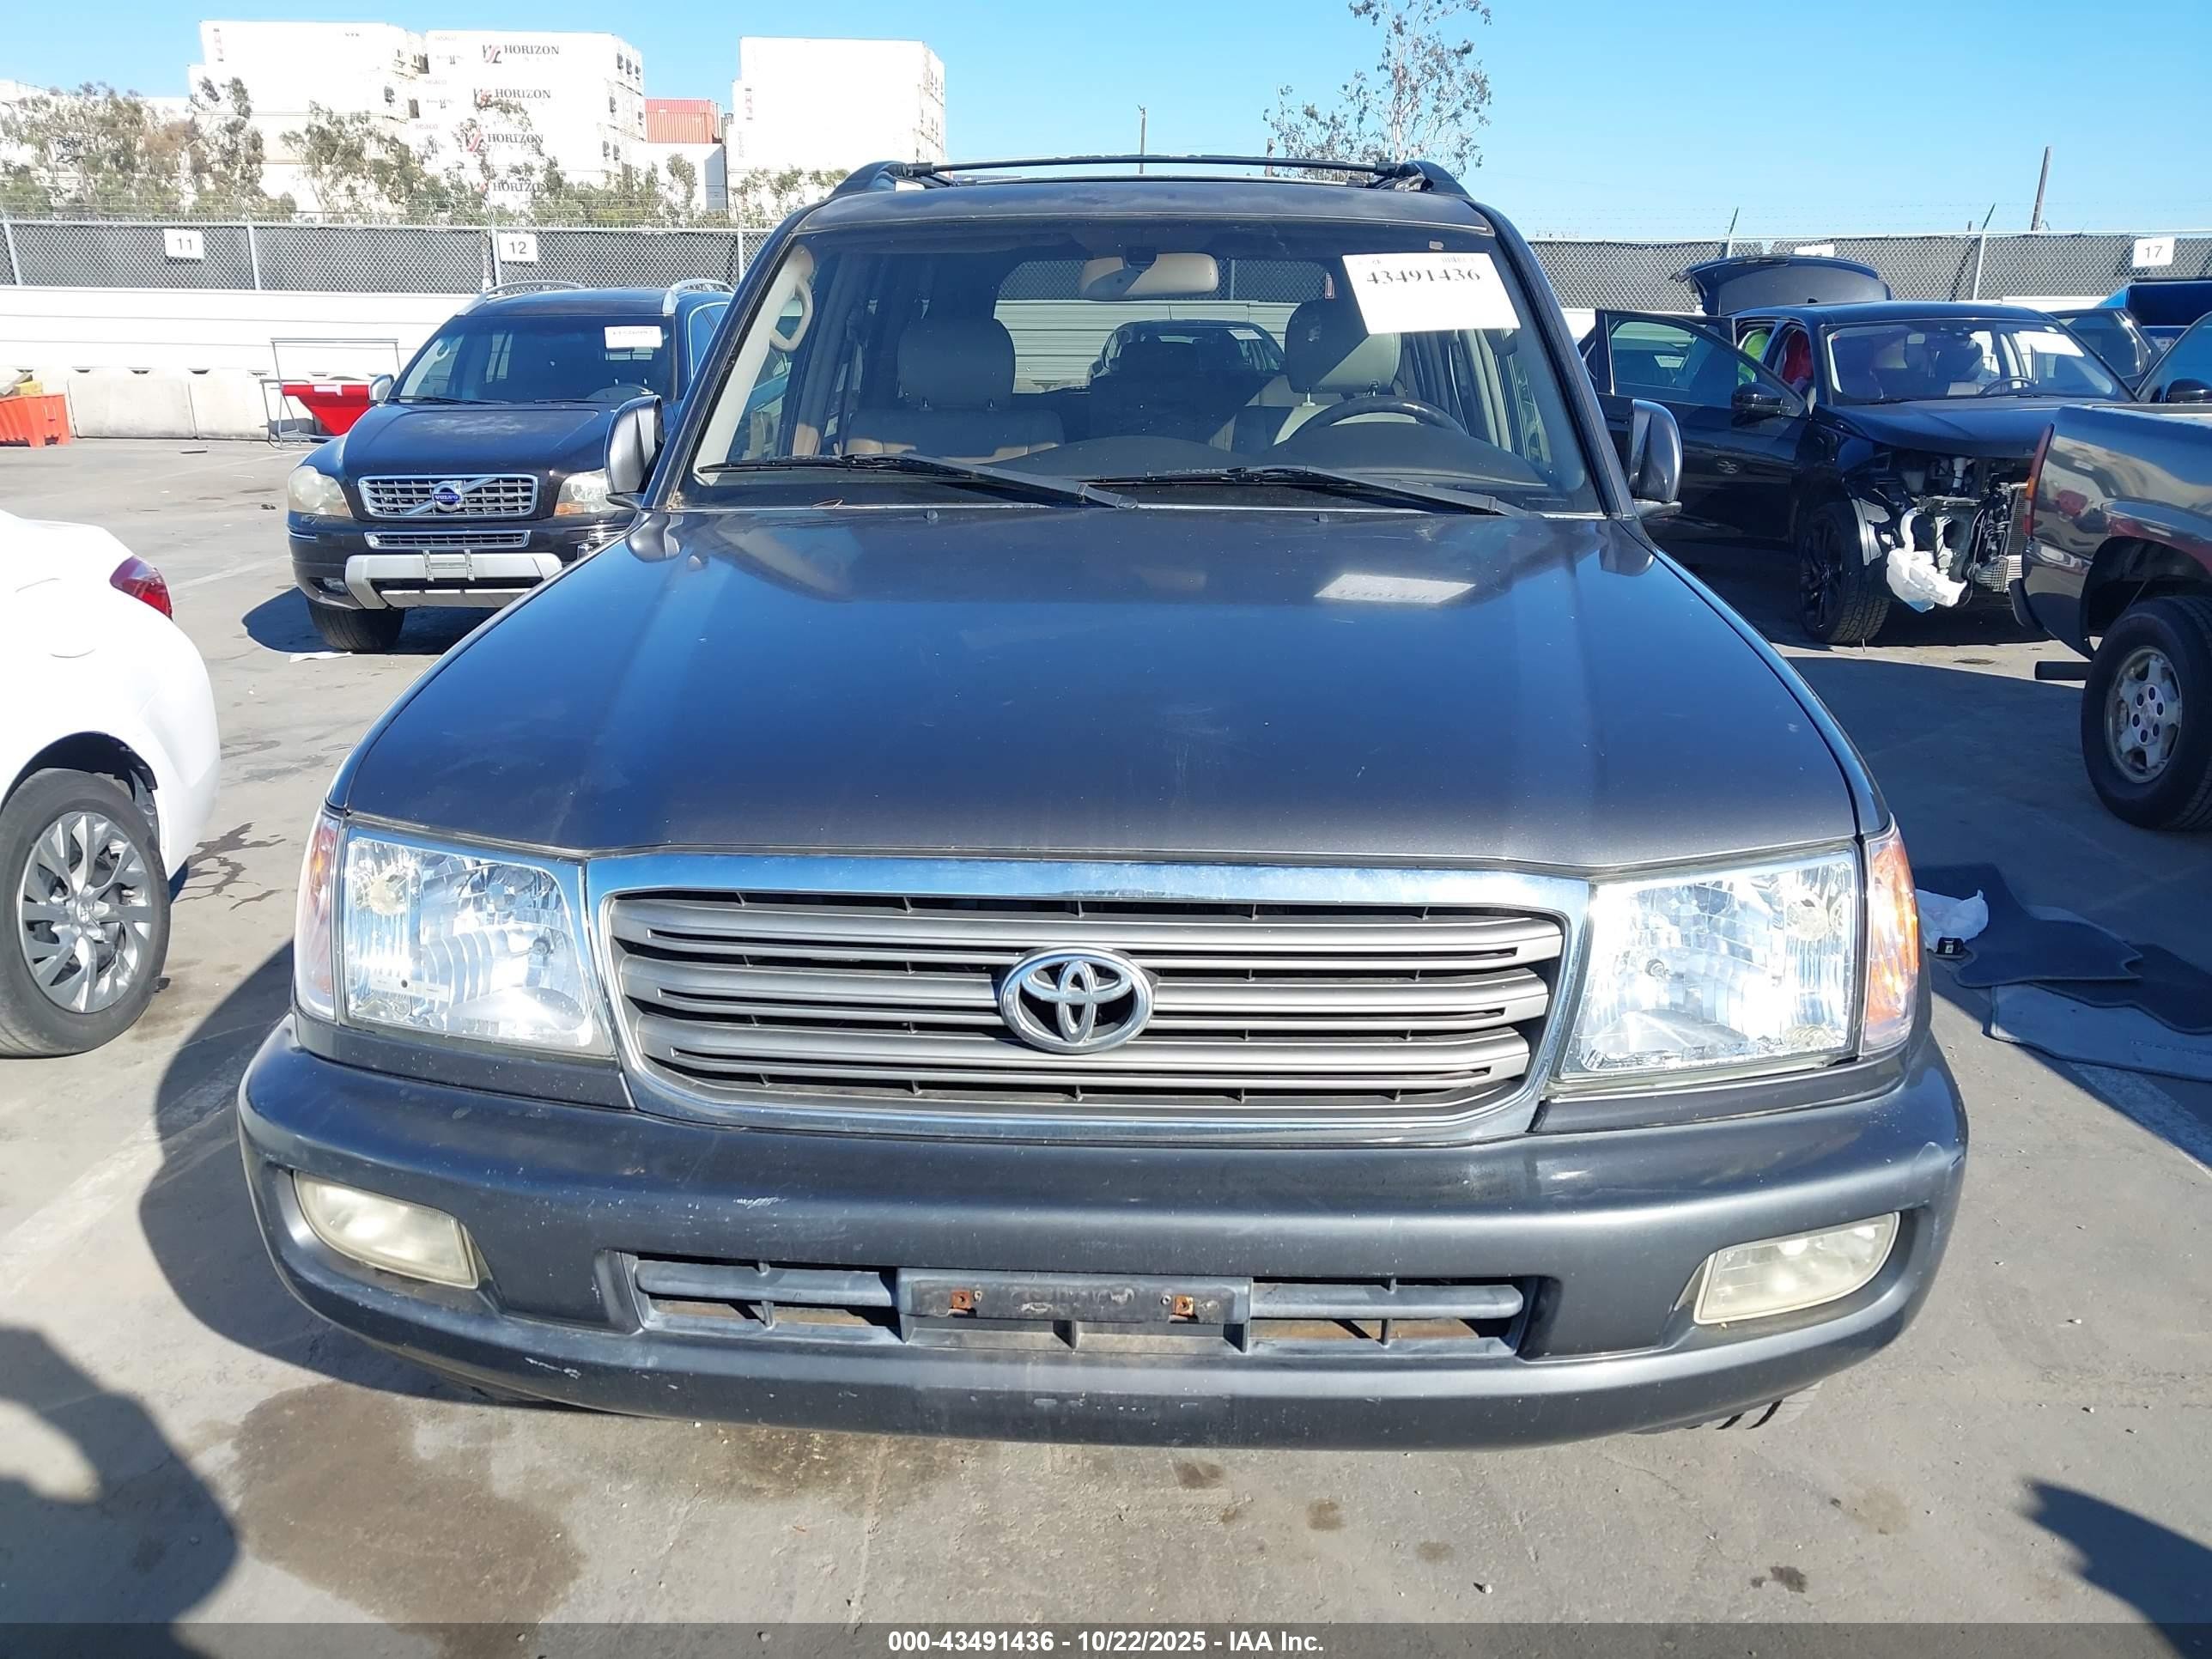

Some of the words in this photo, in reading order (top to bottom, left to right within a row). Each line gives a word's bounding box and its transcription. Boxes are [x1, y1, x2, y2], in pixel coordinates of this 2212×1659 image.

[504, 45, 560, 55] HORIZON
[495, 88, 551, 99] HORIZON
[488, 133, 544, 143] HORIZON
[176, 237, 192, 250] 11
[509, 240, 527, 254] 12
[2145, 245, 2163, 258] 17
[1366, 268, 1481, 285] 43491436
